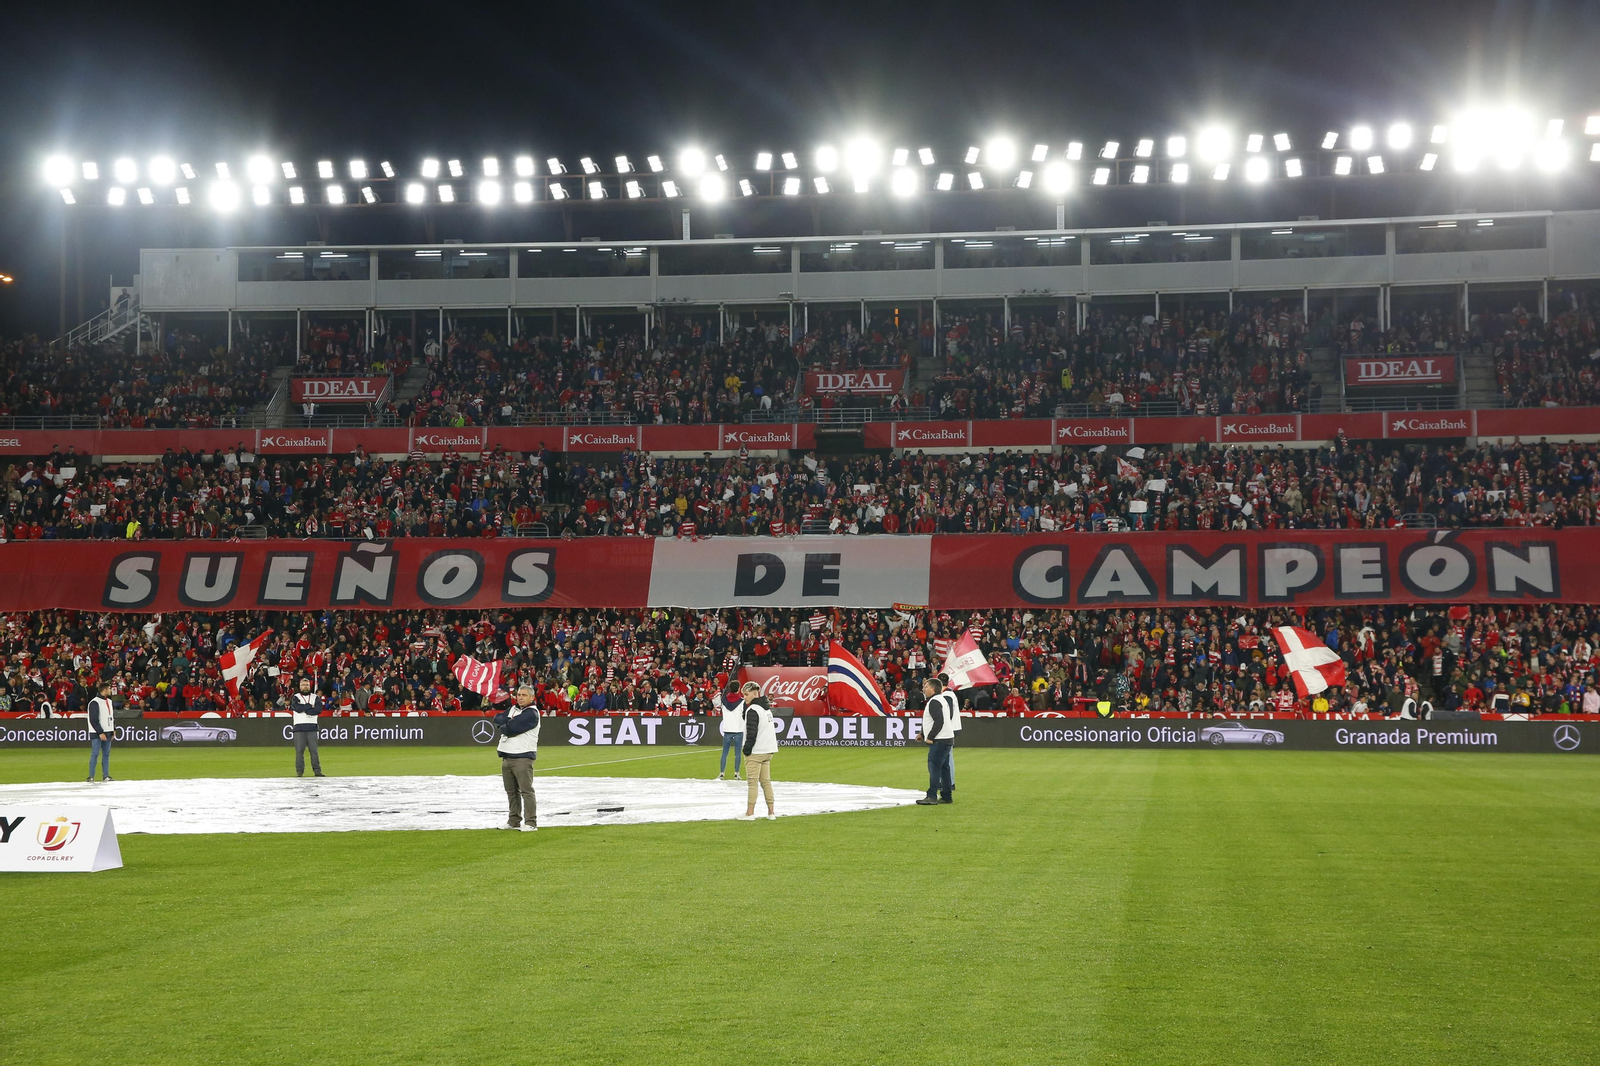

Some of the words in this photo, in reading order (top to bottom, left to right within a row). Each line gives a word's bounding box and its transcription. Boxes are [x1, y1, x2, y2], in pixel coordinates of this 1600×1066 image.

[1357, 360, 1442, 380] IDEAL
[816, 372, 893, 392] IDEAL
[302, 380, 376, 398] IDEAL
[1239, 423, 1295, 434] CaixaBank
[1409, 418, 1467, 430] CaixaBank
[739, 431, 791, 443] CaixaBank
[912, 429, 966, 440] CaixaBank
[1073, 426, 1128, 438] CaixaBank
[276, 436, 327, 448] CaixaBank
[429, 434, 481, 446] CaixaBank
[584, 433, 636, 445] CaixaBank
[104, 541, 555, 606] SUEÑOS
[733, 552, 842, 597] DE
[1015, 530, 1558, 602] CAMPEÓN
[282, 724, 348, 740] Gada
[354, 724, 424, 740] Premium
[568, 717, 662, 745] SEAT
[818, 717, 875, 740] DEL
[885, 717, 923, 740] RE
[1020, 725, 1141, 742] Concesionario
[1335, 727, 1411, 745] Granada
[1417, 728, 1498, 746] Premium
[814, 738, 839, 747] ESPAÑA
